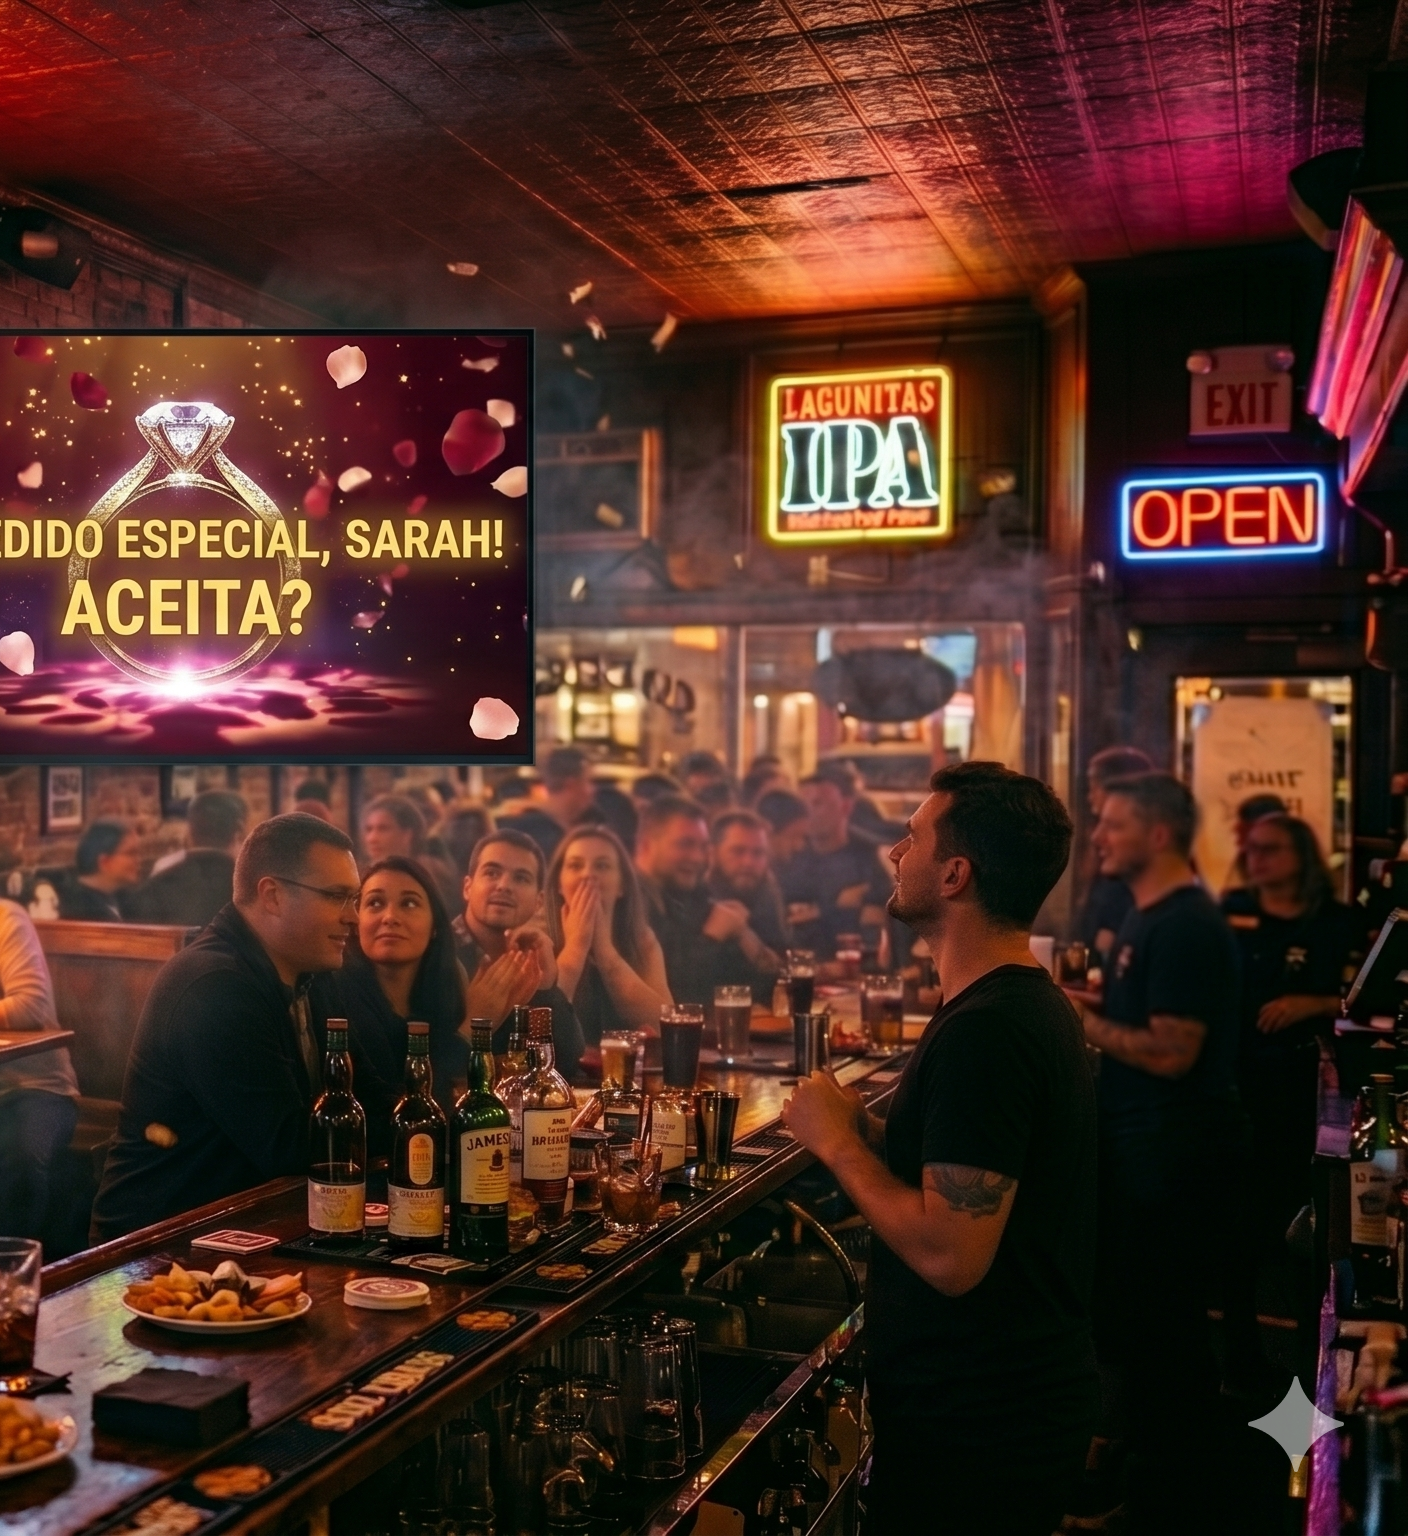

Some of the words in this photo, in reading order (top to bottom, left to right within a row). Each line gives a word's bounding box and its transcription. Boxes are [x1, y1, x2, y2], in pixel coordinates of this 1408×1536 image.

[782, 380, 936, 420] LAGUNITAS
[1205, 381, 1279, 428] EXIT
[780, 415, 940, 512] IPA
[1132, 482, 1315, 547] OPEN
[117, 519, 331, 568] ESPECIAL,
[345, 519, 504, 559] SARAH!
[59, 578, 313, 636] ACEITA?
